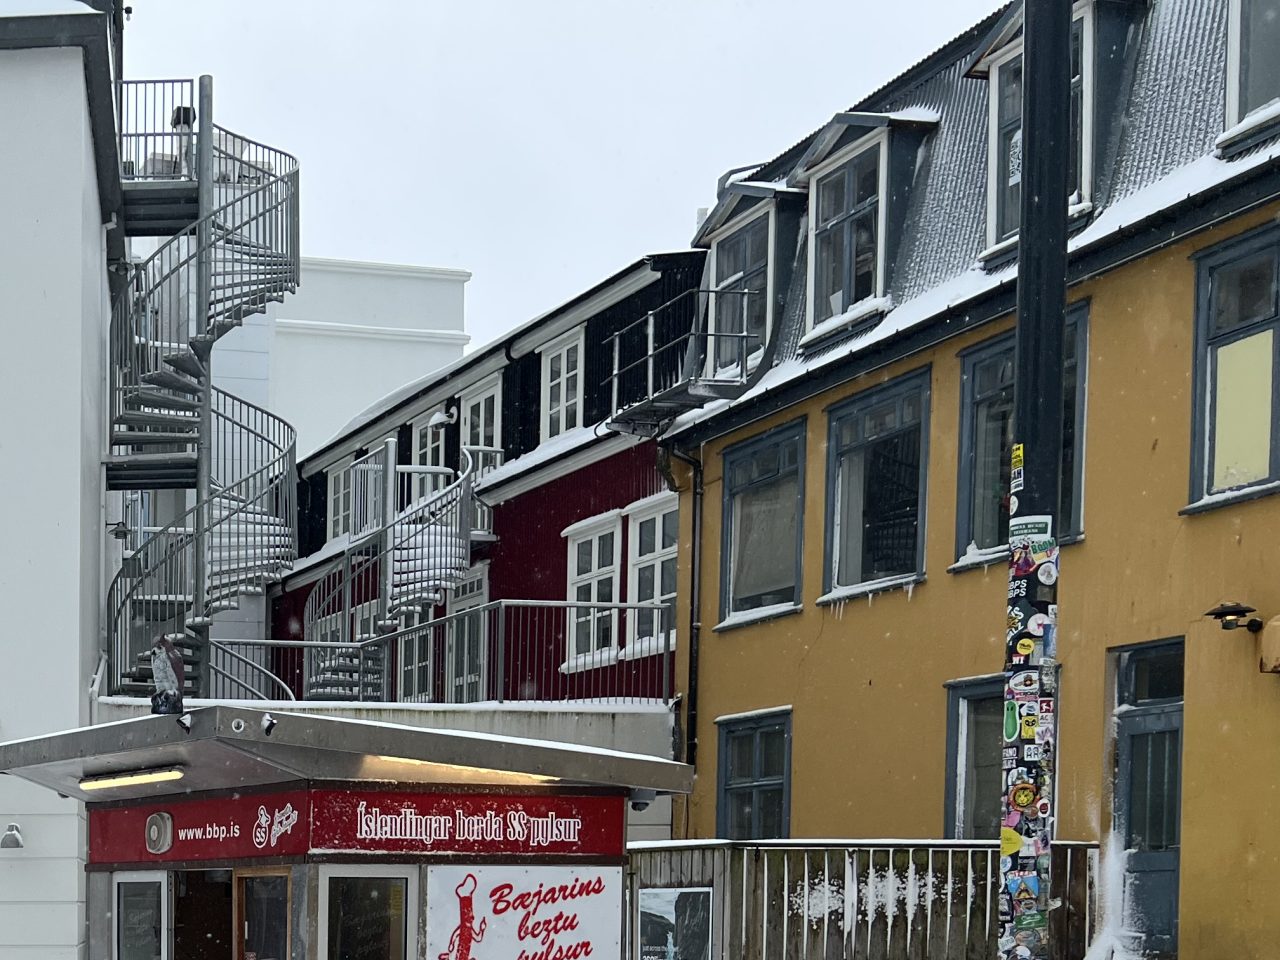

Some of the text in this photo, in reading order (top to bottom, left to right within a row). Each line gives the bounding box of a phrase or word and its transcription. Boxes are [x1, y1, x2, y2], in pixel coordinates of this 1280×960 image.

[178, 821, 240, 841] www.bbp.is
[255, 827, 266, 843] SS
[357, 802, 582, 846] Íslendingar borða SS pylsur
[489, 876, 606, 915] Bæjarins
[517, 911, 579, 946] beztu
